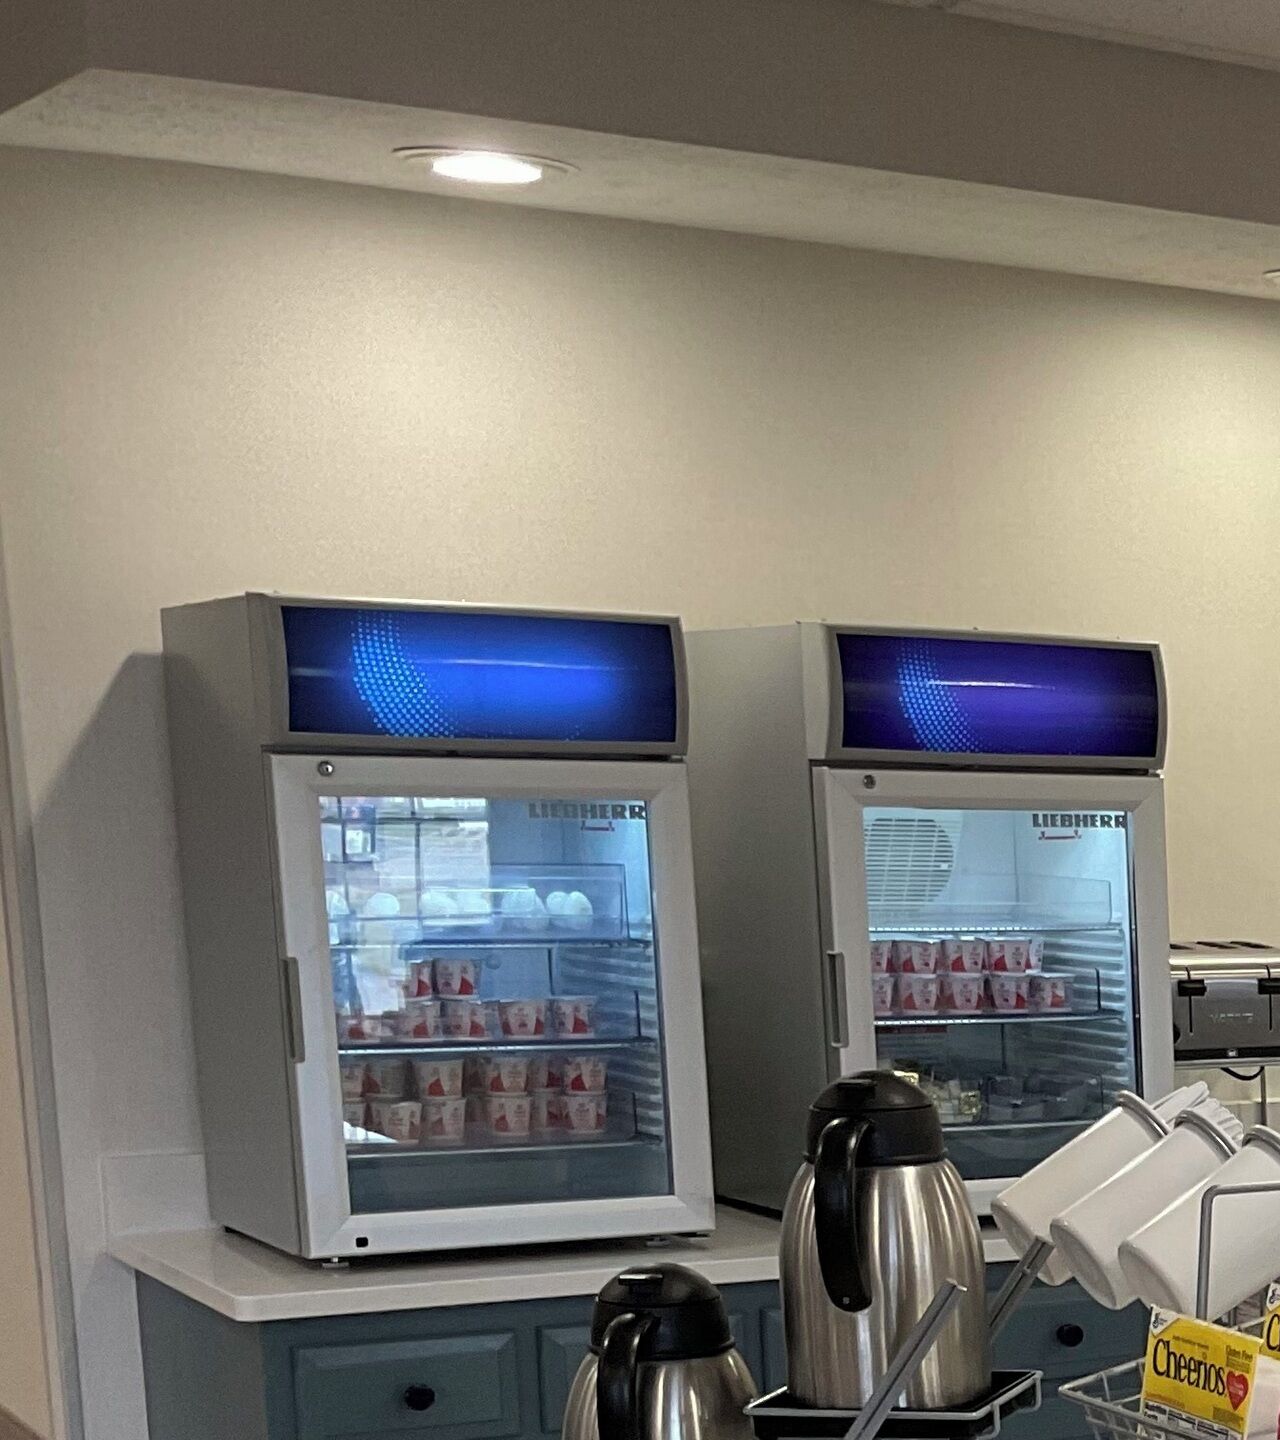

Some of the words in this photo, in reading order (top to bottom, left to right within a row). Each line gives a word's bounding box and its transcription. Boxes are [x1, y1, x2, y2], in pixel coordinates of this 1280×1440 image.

[528, 803, 646, 820] LIEBHERR
[1032, 813, 1127, 829] LIEBHERR
[1152, 1338, 1226, 1396] Cheerios
